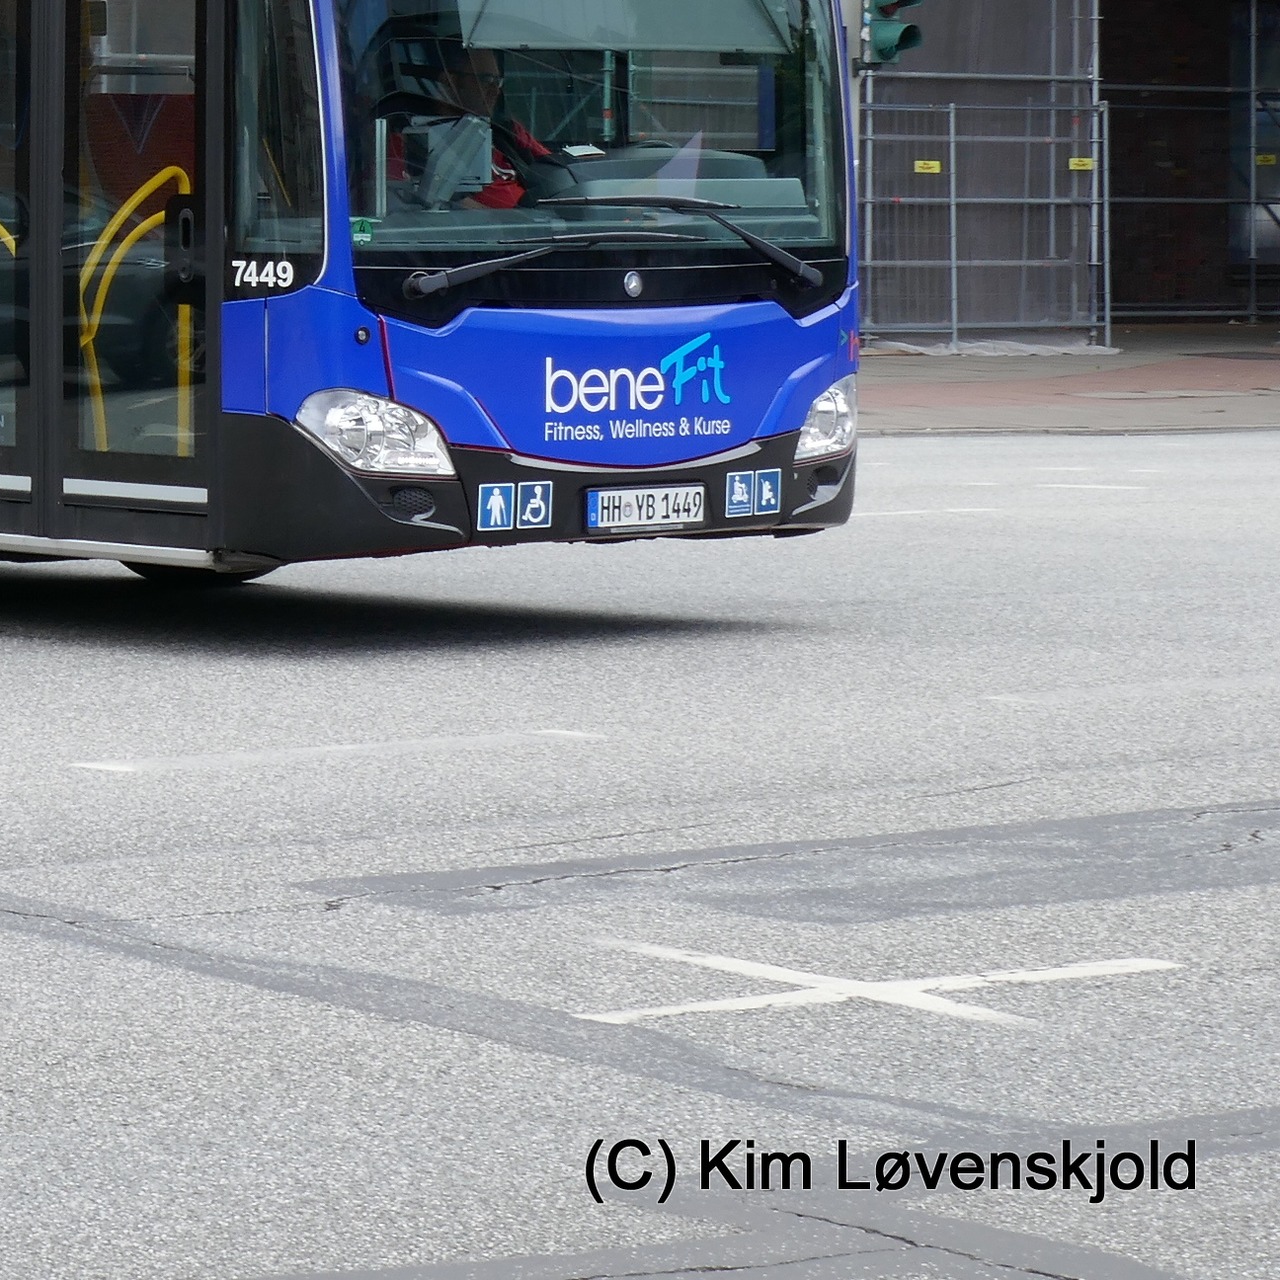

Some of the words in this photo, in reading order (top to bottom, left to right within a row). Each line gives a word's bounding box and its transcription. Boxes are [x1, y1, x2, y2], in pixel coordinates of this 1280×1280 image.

[231, 260, 294, 288] 7449
[544, 421, 604, 442] Fitness,
[609, 418, 675, 439] Wellness
[679, 417, 690, 436] &
[694, 416, 732, 436] Kurse
[600, 495, 622, 523] HH
[635, 493, 656, 520] YB
[661, 490, 703, 519] 1449
